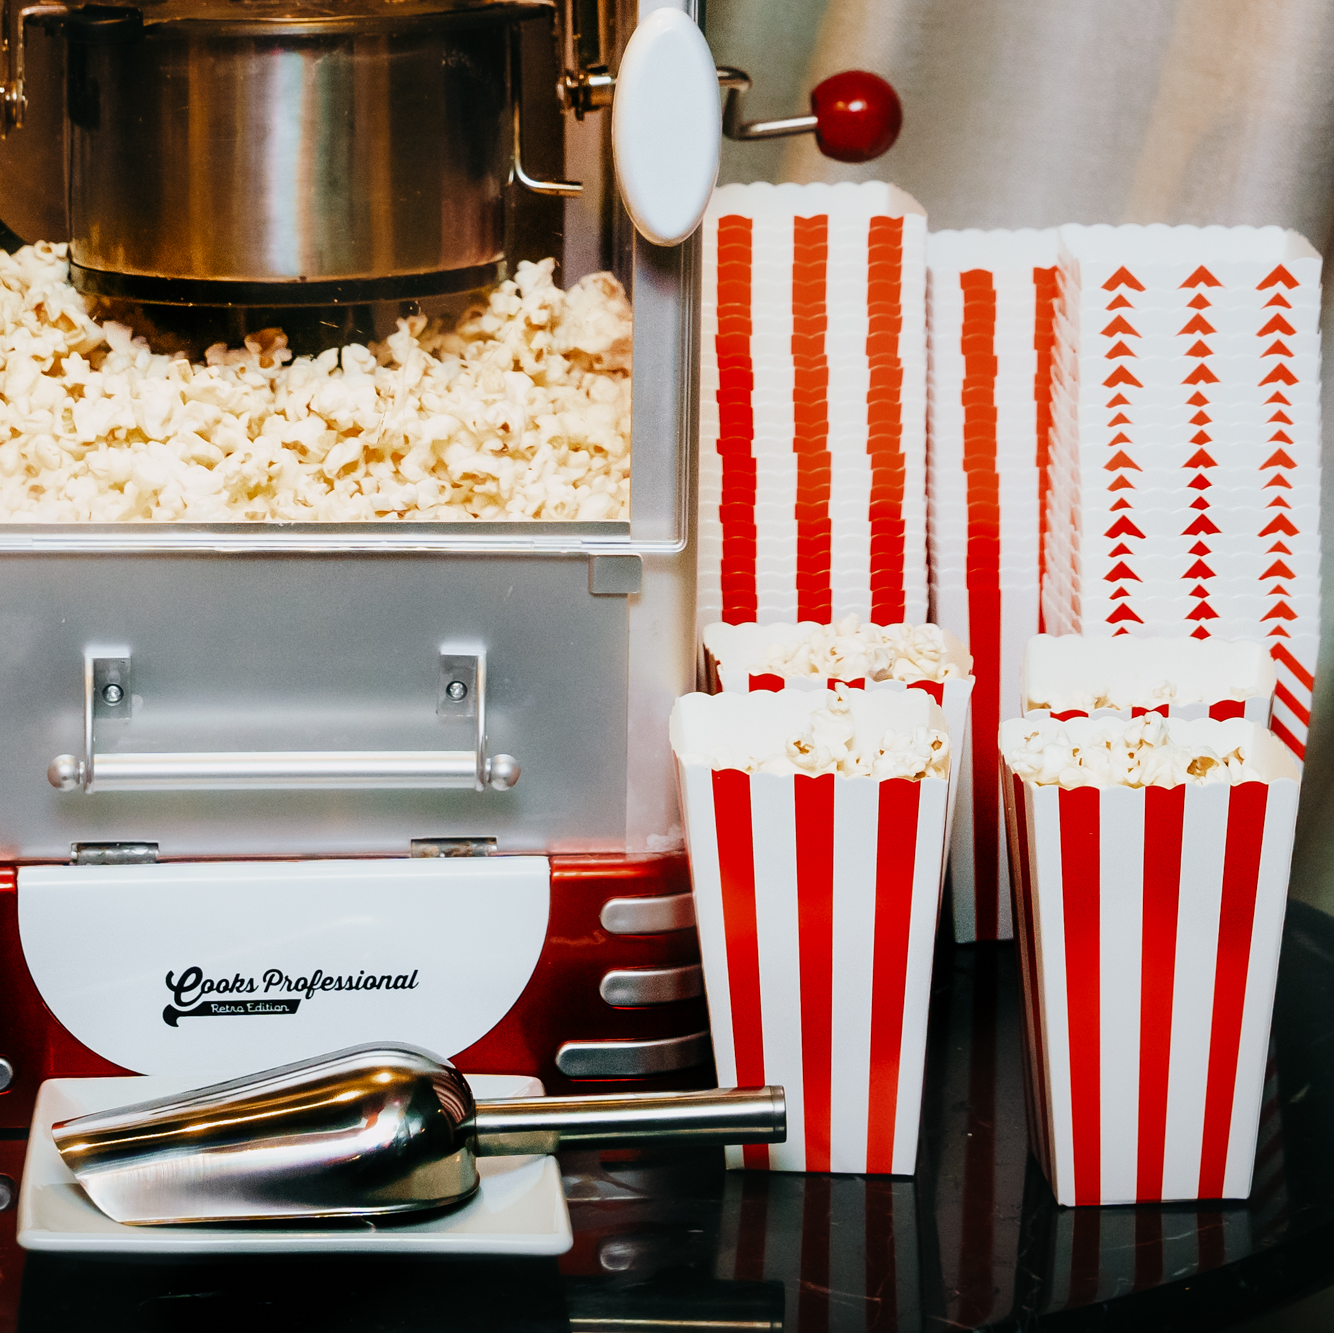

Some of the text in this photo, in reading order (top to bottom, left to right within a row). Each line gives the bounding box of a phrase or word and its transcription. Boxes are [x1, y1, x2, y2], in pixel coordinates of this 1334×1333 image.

[166, 966, 419, 1007] Cooks Professional
[211, 1001, 290, 1014] Retro Edition
